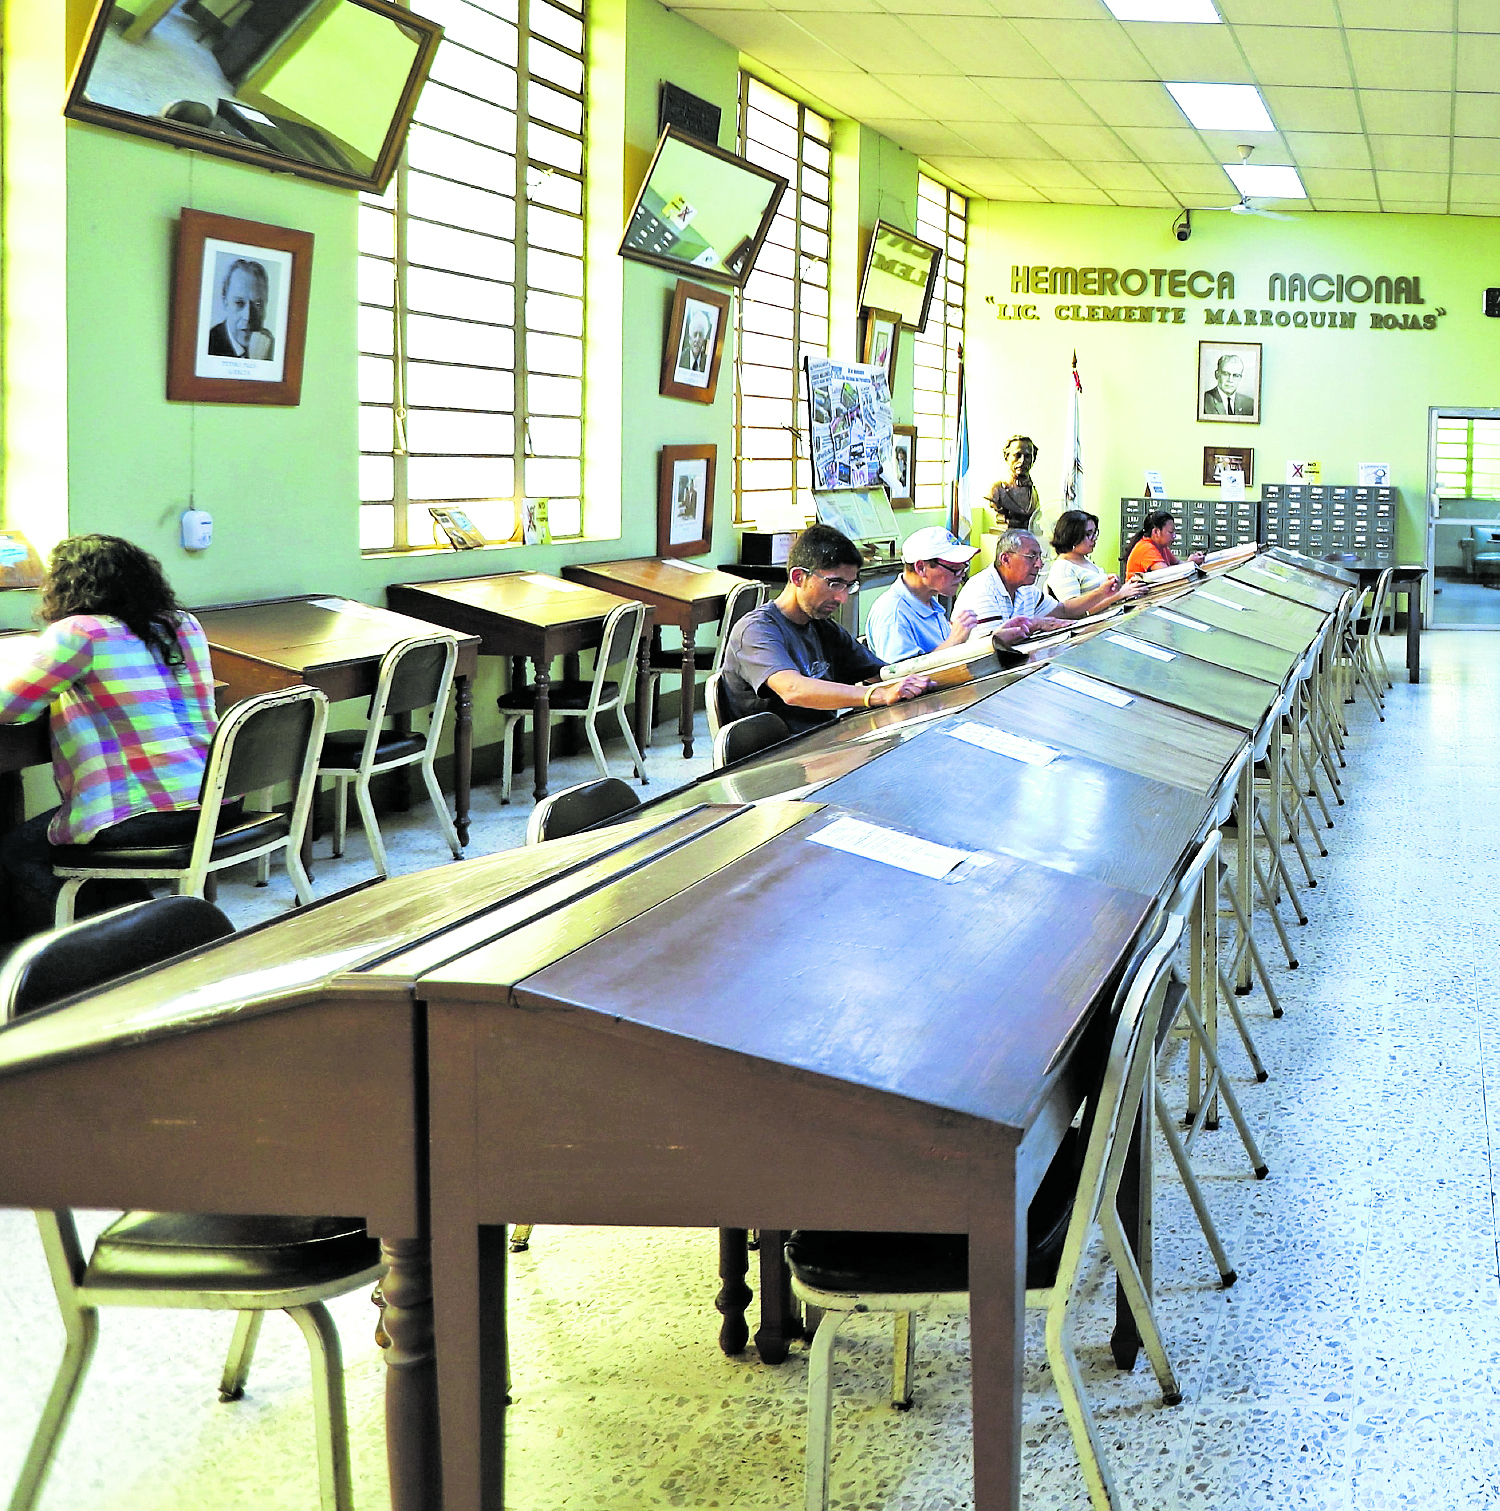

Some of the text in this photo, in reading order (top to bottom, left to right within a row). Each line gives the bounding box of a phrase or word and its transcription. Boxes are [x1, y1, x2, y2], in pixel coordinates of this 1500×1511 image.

[1011, 265, 1425, 304] HEMEROTECA NACIONAL
[1054, 304, 1185, 325] CLEMENTE
[1204, 308, 1355, 329] MARROQUIN
